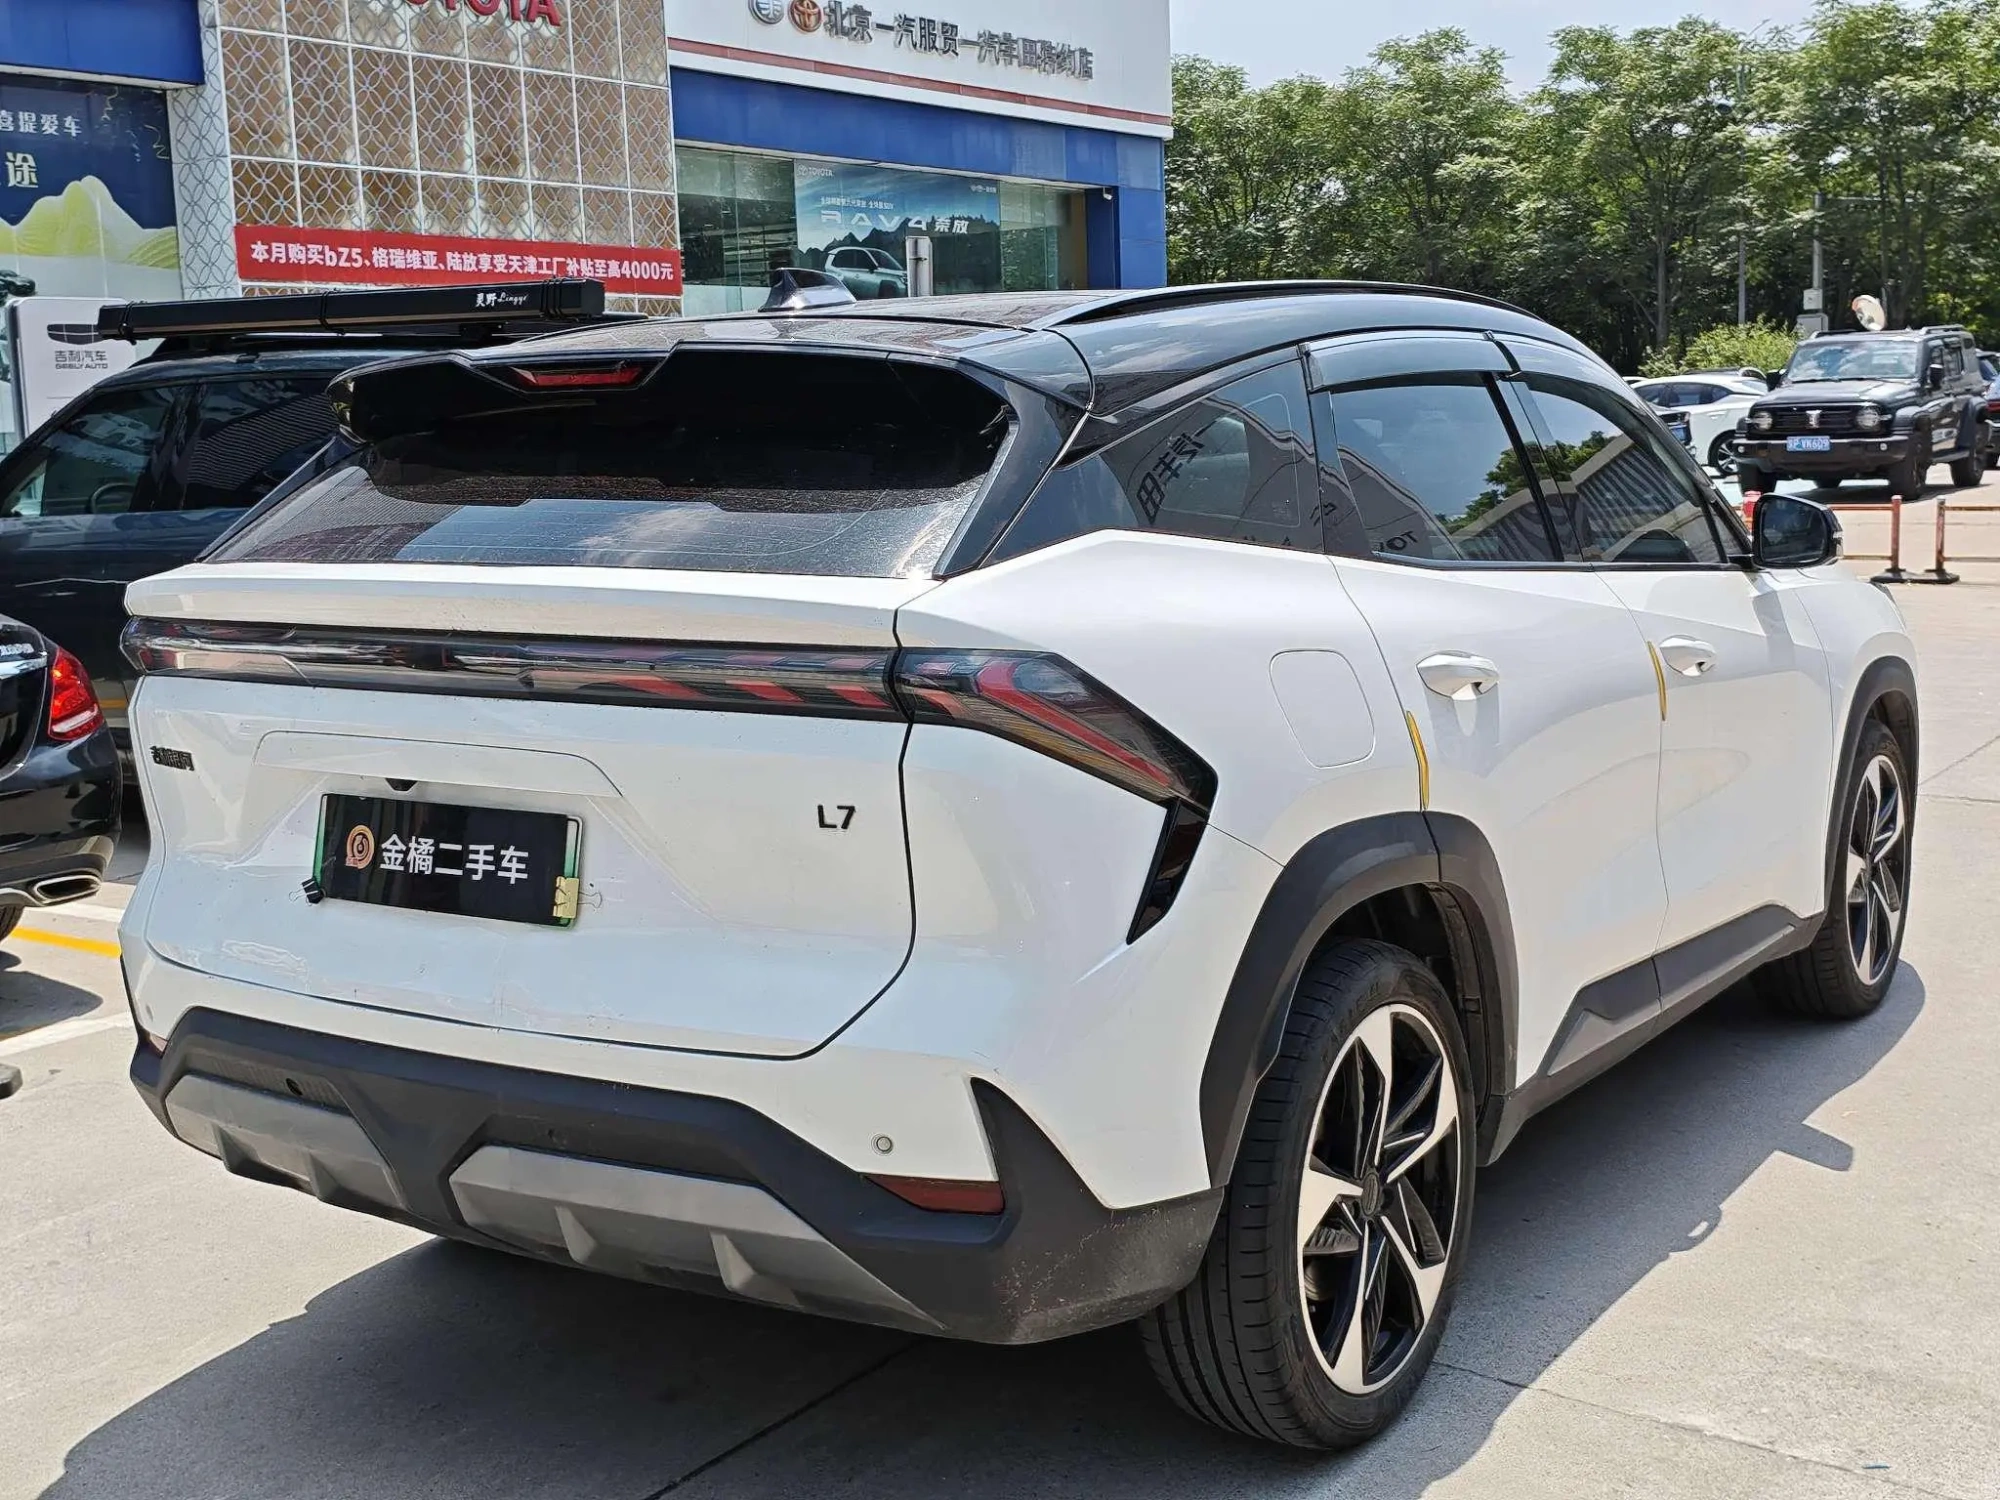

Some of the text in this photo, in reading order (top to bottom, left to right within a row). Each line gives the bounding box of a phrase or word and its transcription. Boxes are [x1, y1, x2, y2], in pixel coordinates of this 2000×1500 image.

[823, 0, 1094, 80] 北京一汽服贸一汽丰田特约店
[0, 110, 82, 137] 喜提爱车
[934, 218, 970, 235] 荣放
[54, 350, 108, 362] 吉利汽车
[817, 804, 856, 830] L7
[379, 833, 529, 884] 金橘二手车
